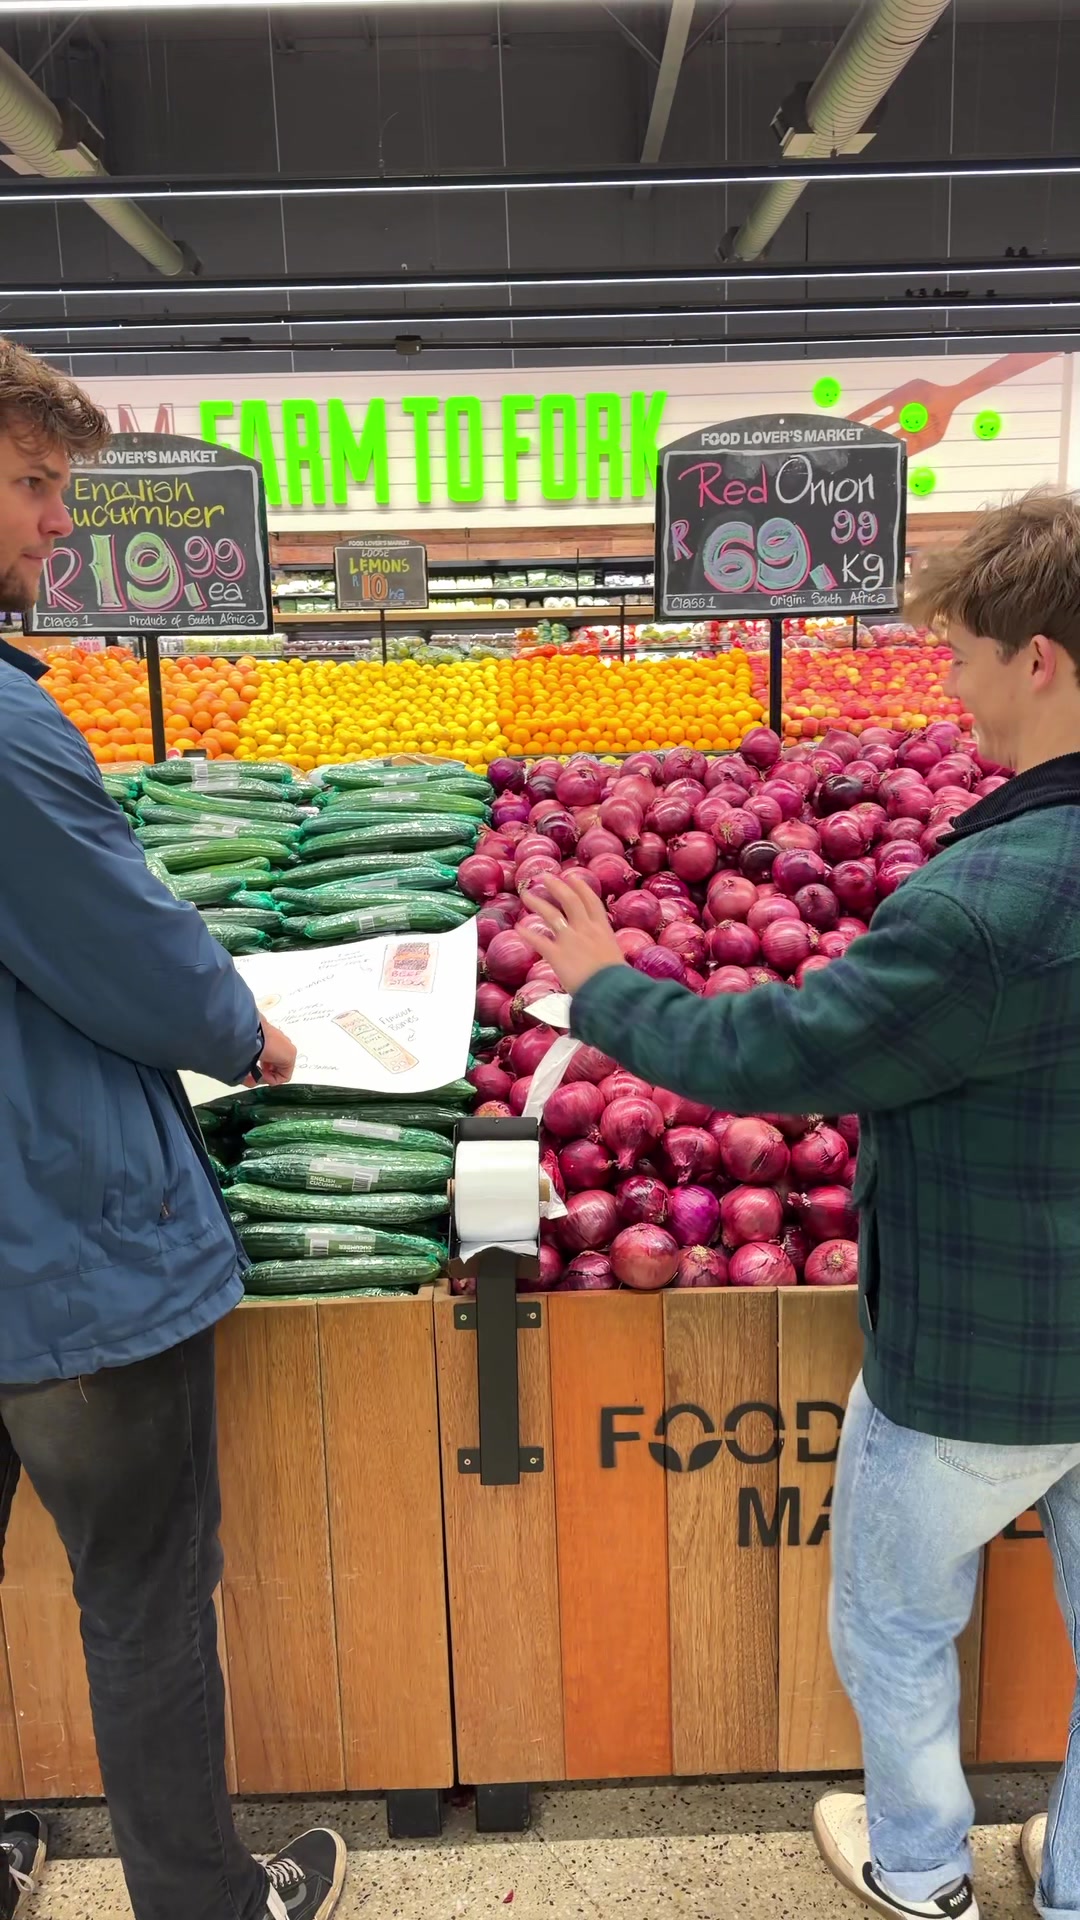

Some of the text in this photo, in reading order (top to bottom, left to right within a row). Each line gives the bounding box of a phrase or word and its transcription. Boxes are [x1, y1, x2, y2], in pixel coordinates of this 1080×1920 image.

[702, 428, 864, 446] FOOD LOVER'S MARKET
[199, 390, 667, 505] FARM TO FORK
[98, 450, 156, 464] LOVER'S
[159, 450, 218, 464] MARKET
[678, 454, 875, 508] Red Onion
[74, 477, 195, 516] English
[64, 504, 225, 529] ucumber
[361, 549, 390, 557] LOOSE
[348, 557, 410, 574] LEMONS
[207, 581, 244, 601] ea
[770, 591, 886, 608] Origin: South Africa
[670, 597, 706, 609] Class
[43, 615, 80, 627] Class
[128, 615, 167, 627] Product
[171, 615, 182, 628] of
[187, 614, 215, 626] South
[309, 1175, 336, 1184] ENGLISH
[599, 1401, 846, 1473] FOOD
[949, 1886, 969, 1907] NIKE
